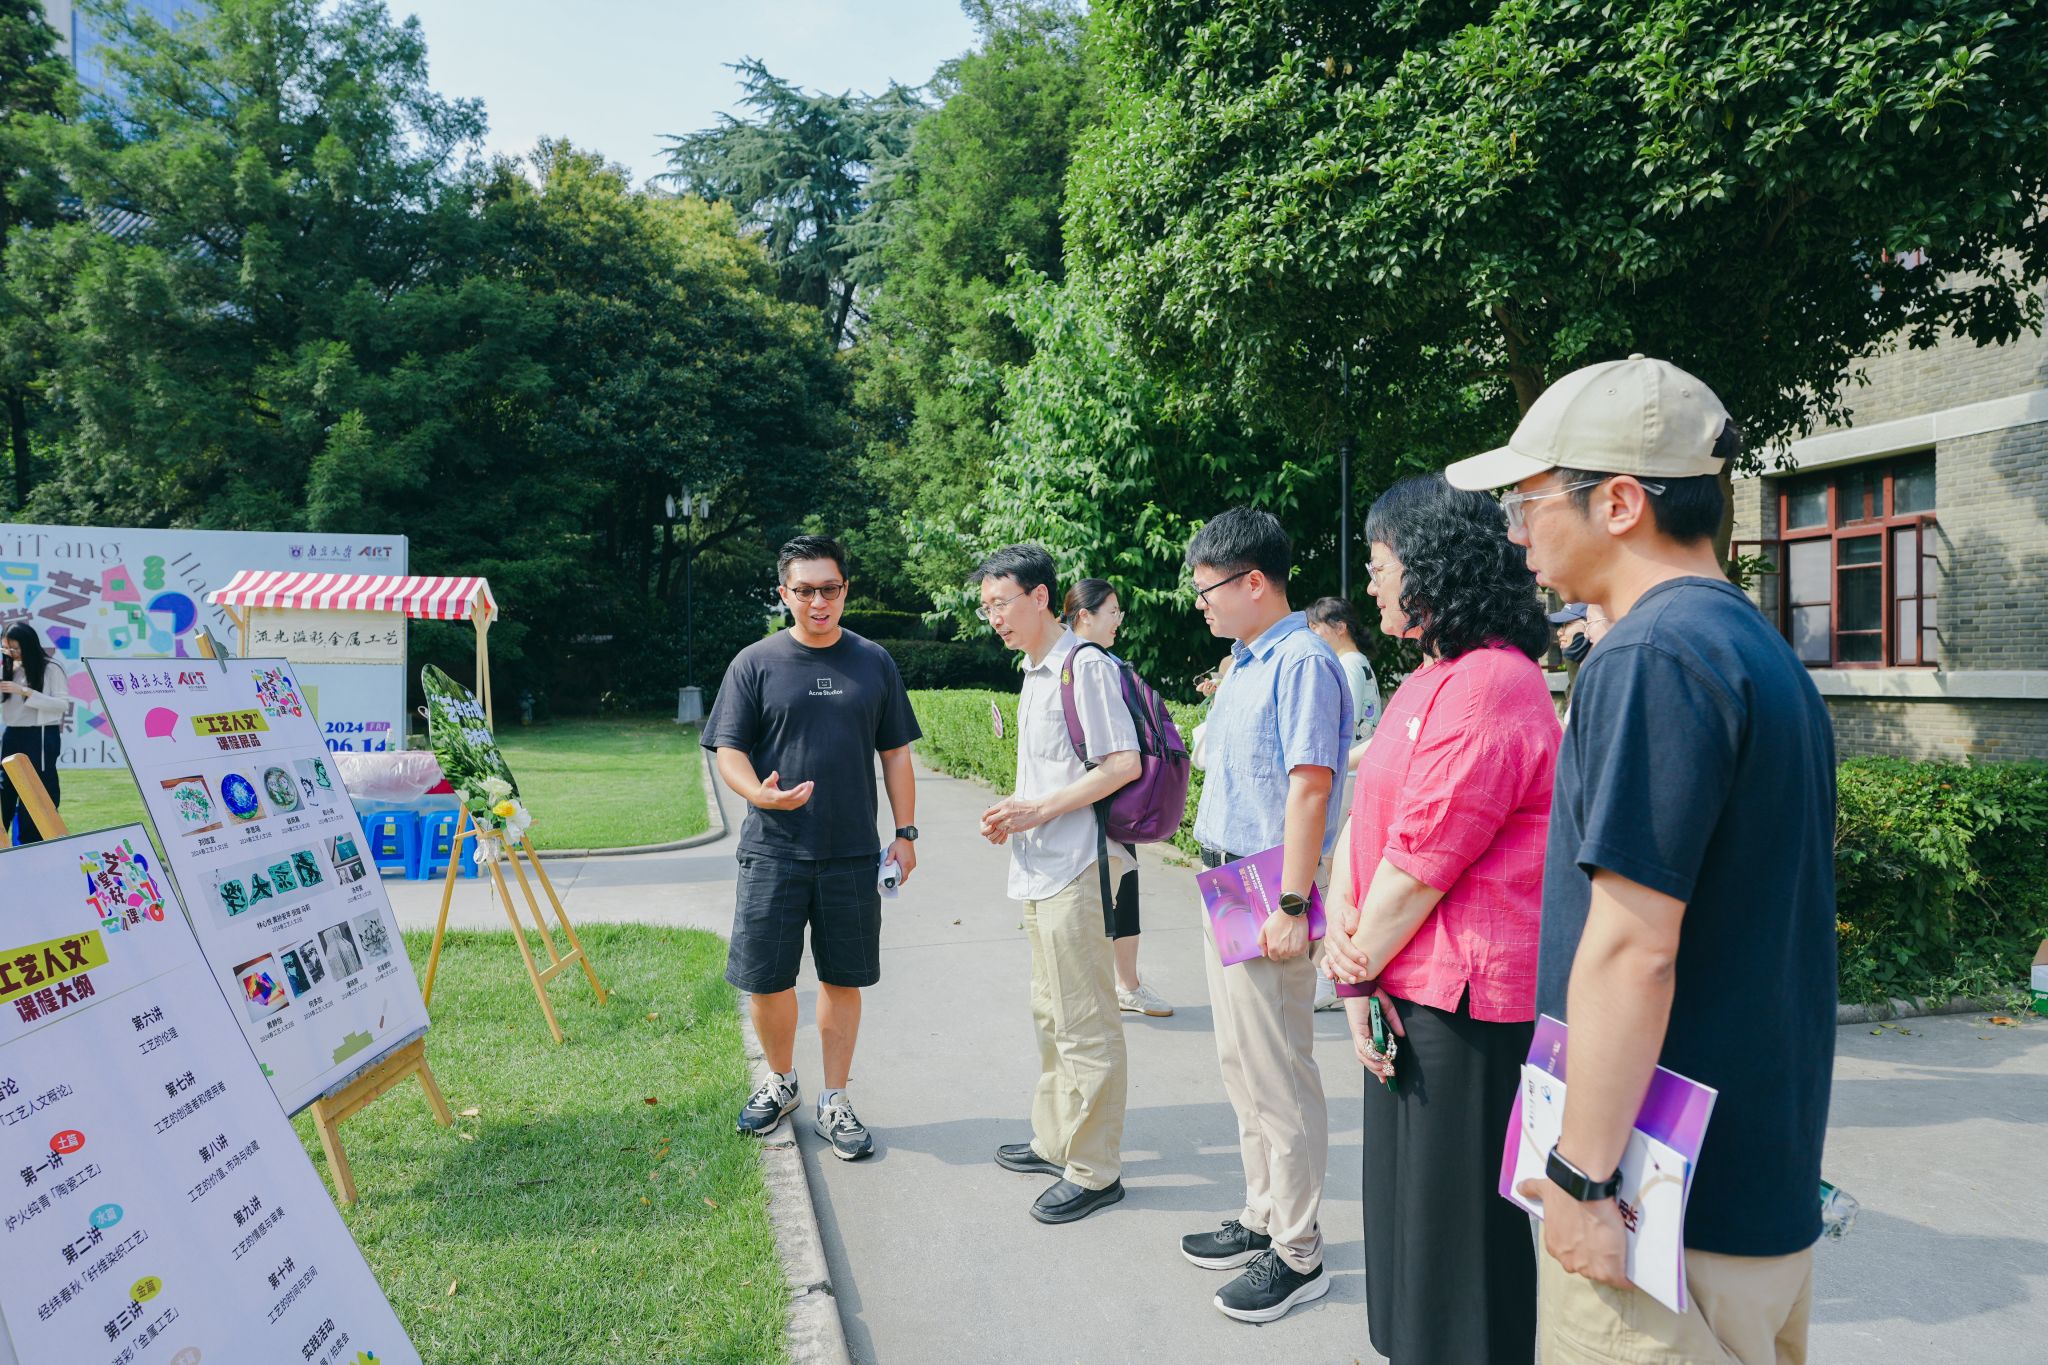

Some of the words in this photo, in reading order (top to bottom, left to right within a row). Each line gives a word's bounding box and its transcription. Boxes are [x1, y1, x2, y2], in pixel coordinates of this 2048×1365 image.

[358, 546, 392, 557] ART
[38, 570, 102, 629] 艺
[177, 671, 206, 685] ART
[216, 733, 261, 751] 课程展品
[325, 722, 364, 733] 2024
[61, 741, 116, 764] ark
[326, 738, 386, 752] 0614
[14, 973, 96, 1023] 课程大纲
[131, 1005, 164, 1032] 第六讲
[139, 1026, 179, 1056] 工艺的伦理
[165, 1070, 196, 1099] 第七讲
[154, 1080, 227, 1135] 工艺的创造者和使用者
[198, 1133, 229, 1163] 第八讲
[20, 1150, 64, 1188] 第一讲
[233, 1194, 262, 1228] 第九讲
[62, 1225, 104, 1266] 第二讲
[232, 1206, 286, 1261] 工艺的情感与审美
[268, 1256, 296, 1290] 第十讲
[267, 1265, 318, 1325] 工艺的时间与空间
[104, 1299, 144, 1342] 第三讲
[302, 1318, 334, 1362] 实践活动
